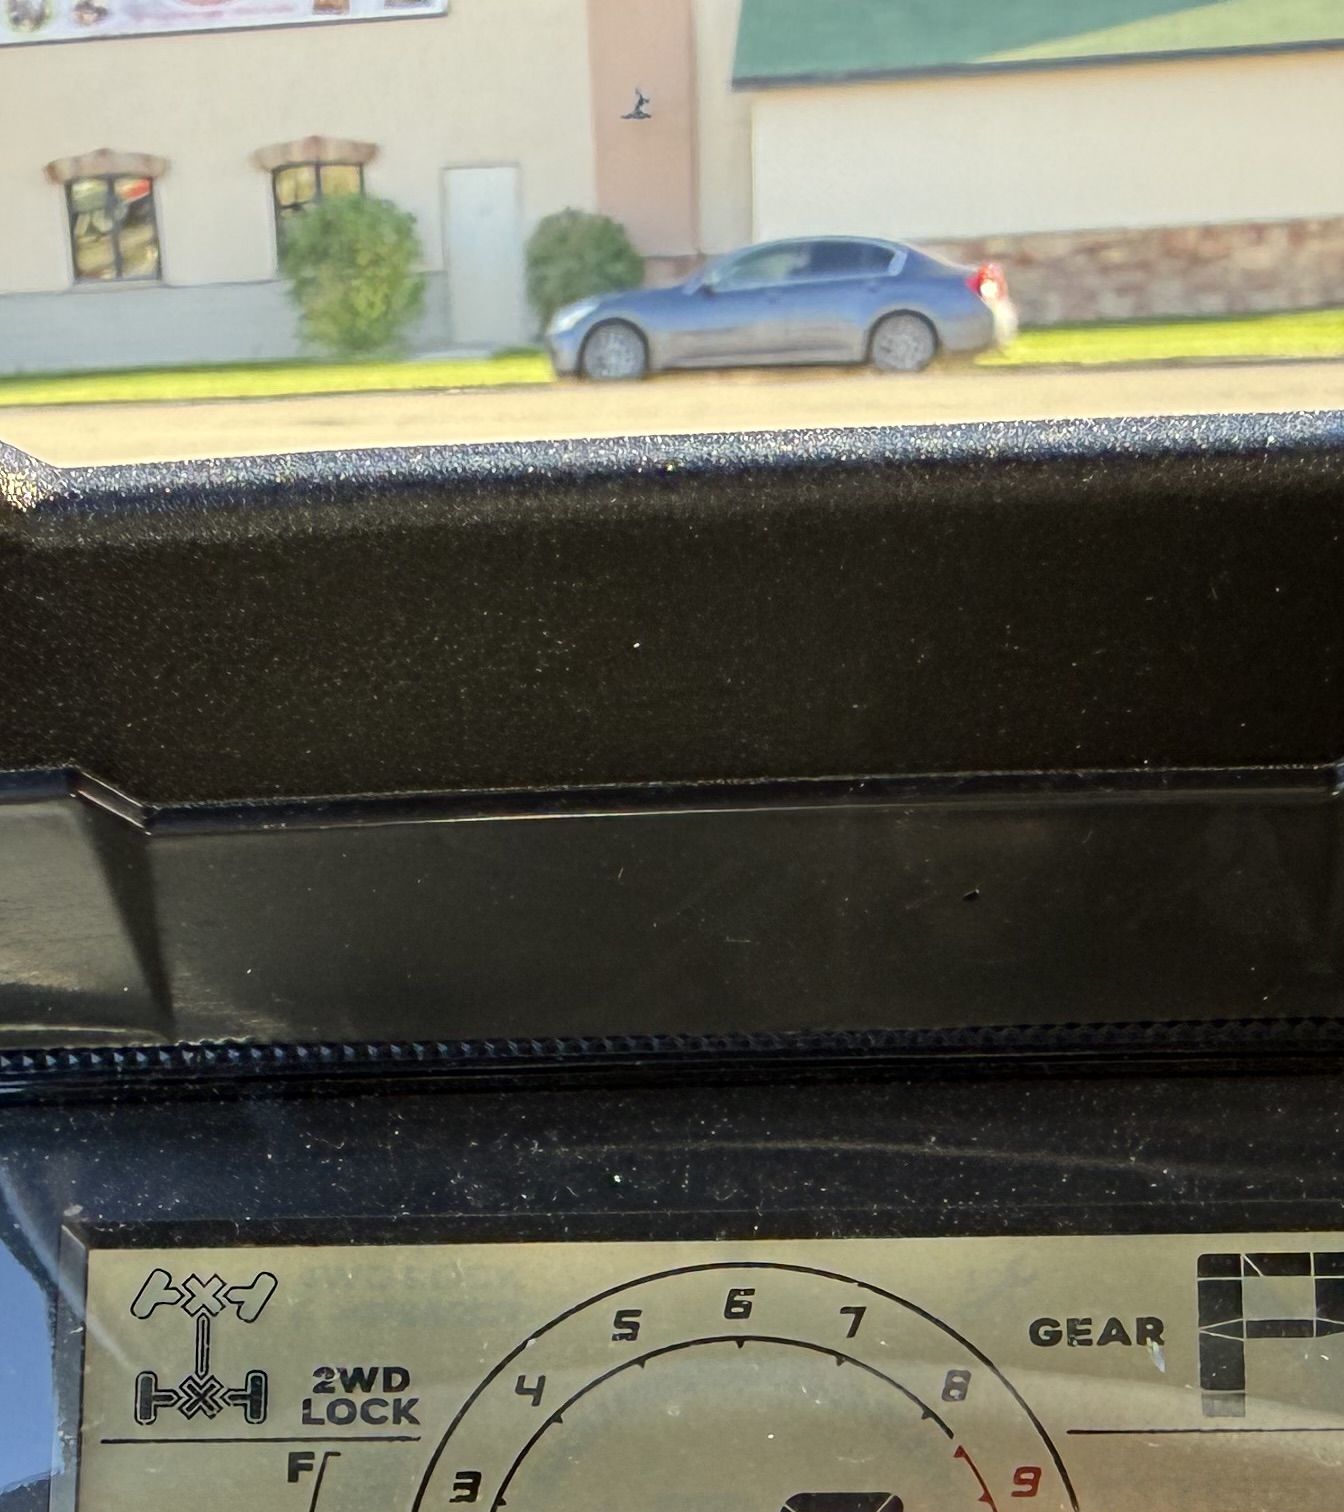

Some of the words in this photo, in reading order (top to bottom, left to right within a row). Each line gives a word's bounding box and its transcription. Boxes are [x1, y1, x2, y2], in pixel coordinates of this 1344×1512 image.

[723, 1288, 755, 1320] 6
[612, 1308, 641, 1342] 5
[839, 1305, 868, 1339] 7
[1028, 1316, 1166, 1348] GEAR
[311, 1366, 411, 1394] 2WD
[514, 1373, 547, 1406] 4
[940, 1368, 974, 1402] 8
[301, 1397, 421, 1426] LOCK
[287, 1452, 316, 1483] F
[1009, 1466, 1043, 1498] 9
[449, 1470, 482, 1503] 3
